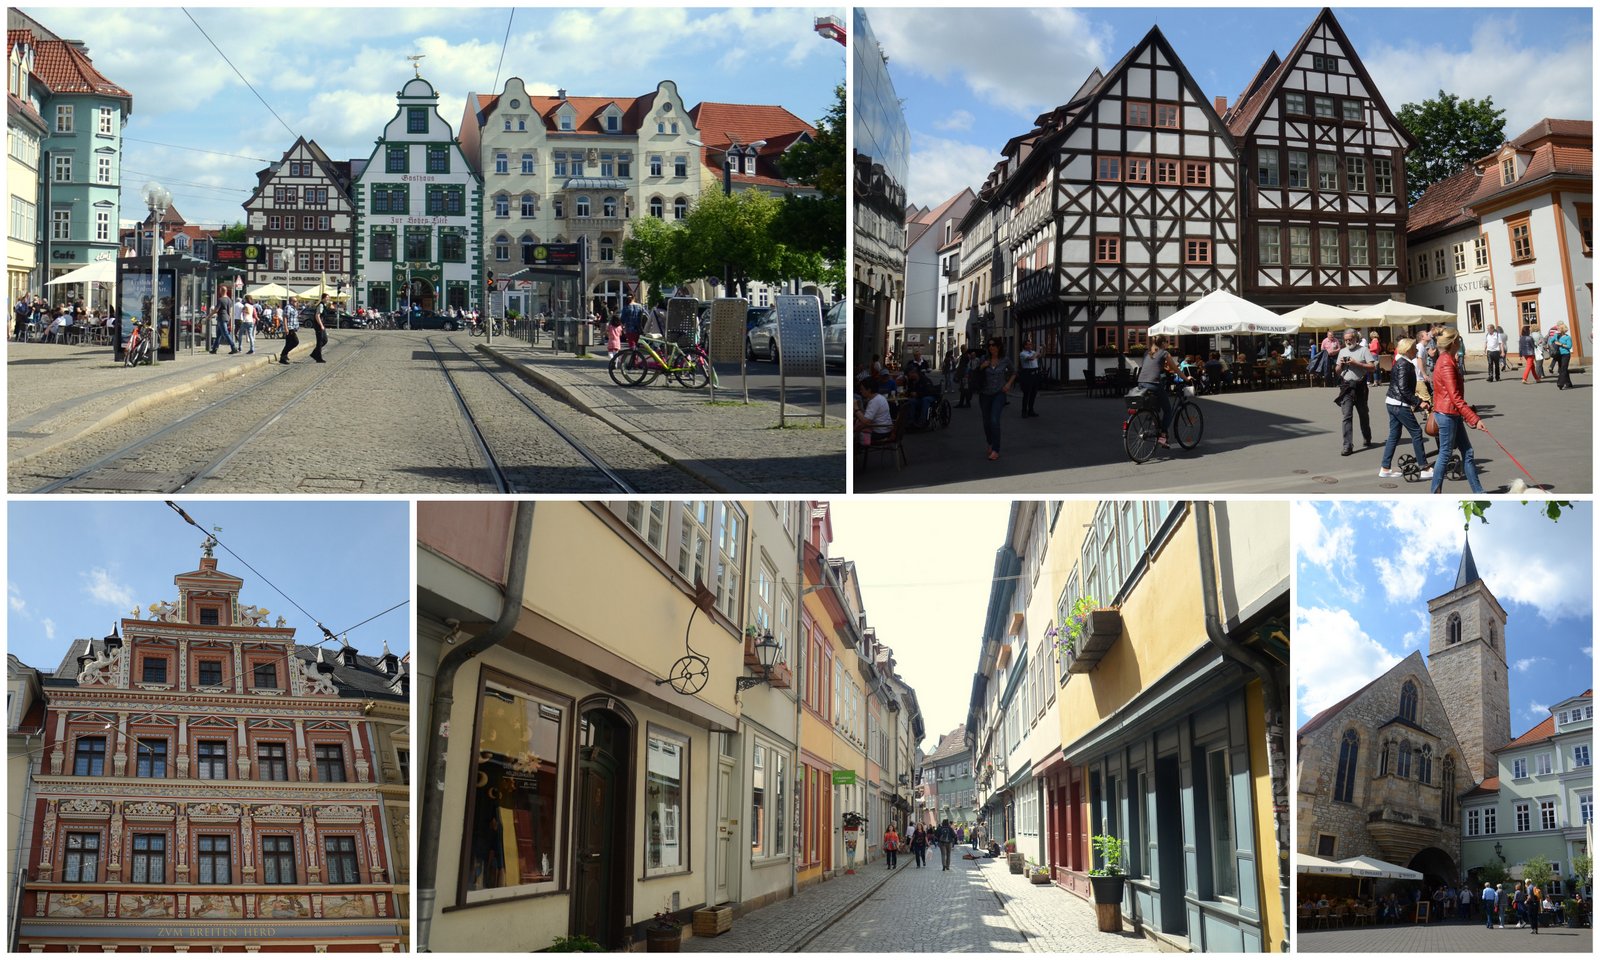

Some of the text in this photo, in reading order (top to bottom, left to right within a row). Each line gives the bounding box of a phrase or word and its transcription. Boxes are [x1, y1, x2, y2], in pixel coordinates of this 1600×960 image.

[53, 250, 76, 260] Café
[158, 928, 276, 937] ZVM BREITEN HERD
